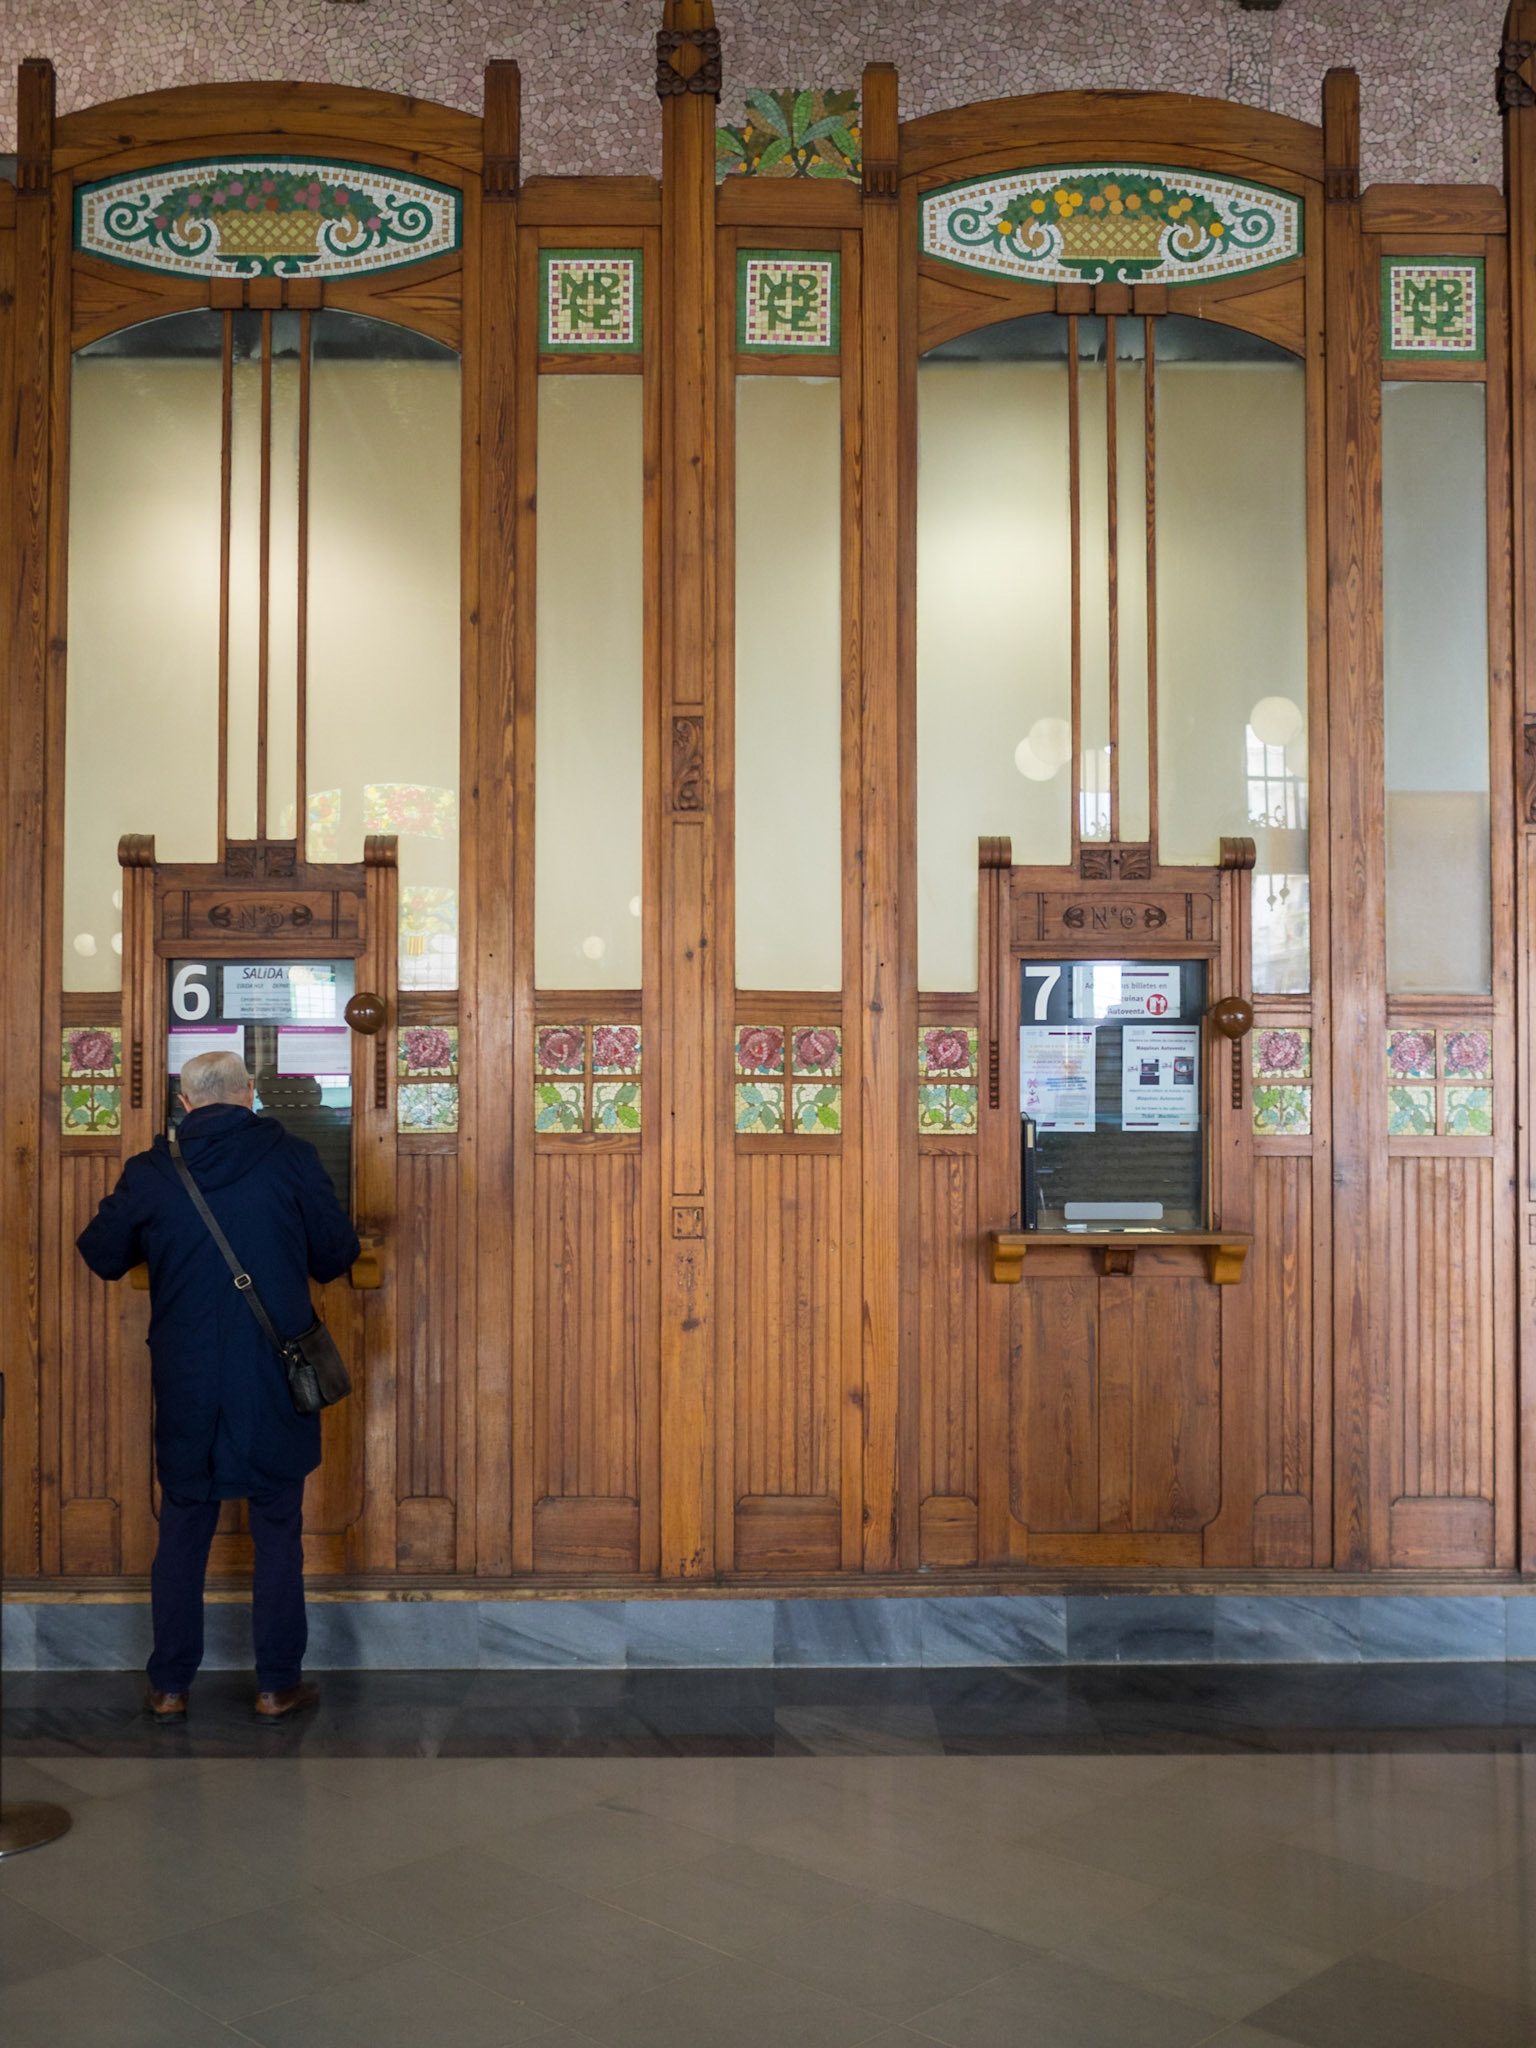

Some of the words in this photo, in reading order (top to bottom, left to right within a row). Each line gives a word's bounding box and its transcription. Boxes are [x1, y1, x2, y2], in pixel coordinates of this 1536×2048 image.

[171, 964, 211, 1021] 6
[1025, 966, 1061, 1021] 7
[1131, 982, 1157, 990] billetes
